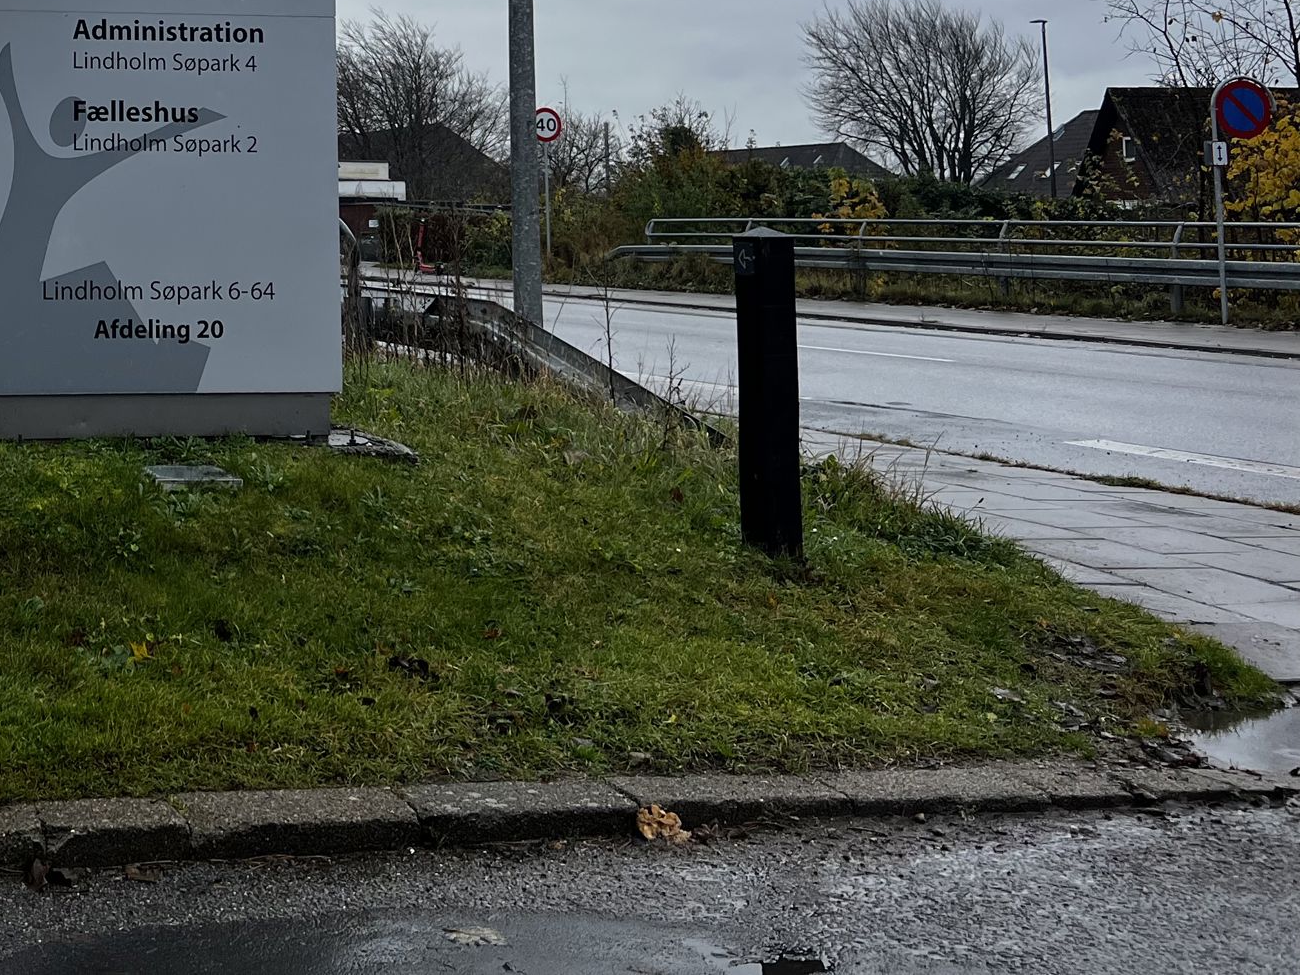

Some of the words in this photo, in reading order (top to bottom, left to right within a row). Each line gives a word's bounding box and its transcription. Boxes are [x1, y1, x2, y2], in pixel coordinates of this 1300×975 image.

[72, 19, 264, 43] Administration
[73, 51, 166, 71] Lindholm
[172, 53, 240, 76] Søpark
[245, 55, 257, 72] 4
[72, 100, 199, 123] Fælleshus
[536, 118, 557, 132] 40
[73, 133, 167, 152] Lindholm
[173, 135, 241, 157] Søpark
[247, 136, 258, 153] 2
[42, 280, 143, 300] Lindholm
[150, 280, 223, 305] Søpark
[228, 281, 276, 301] 6-64
[94, 319, 191, 344] Afdeling
[196, 320, 225, 340] 20
